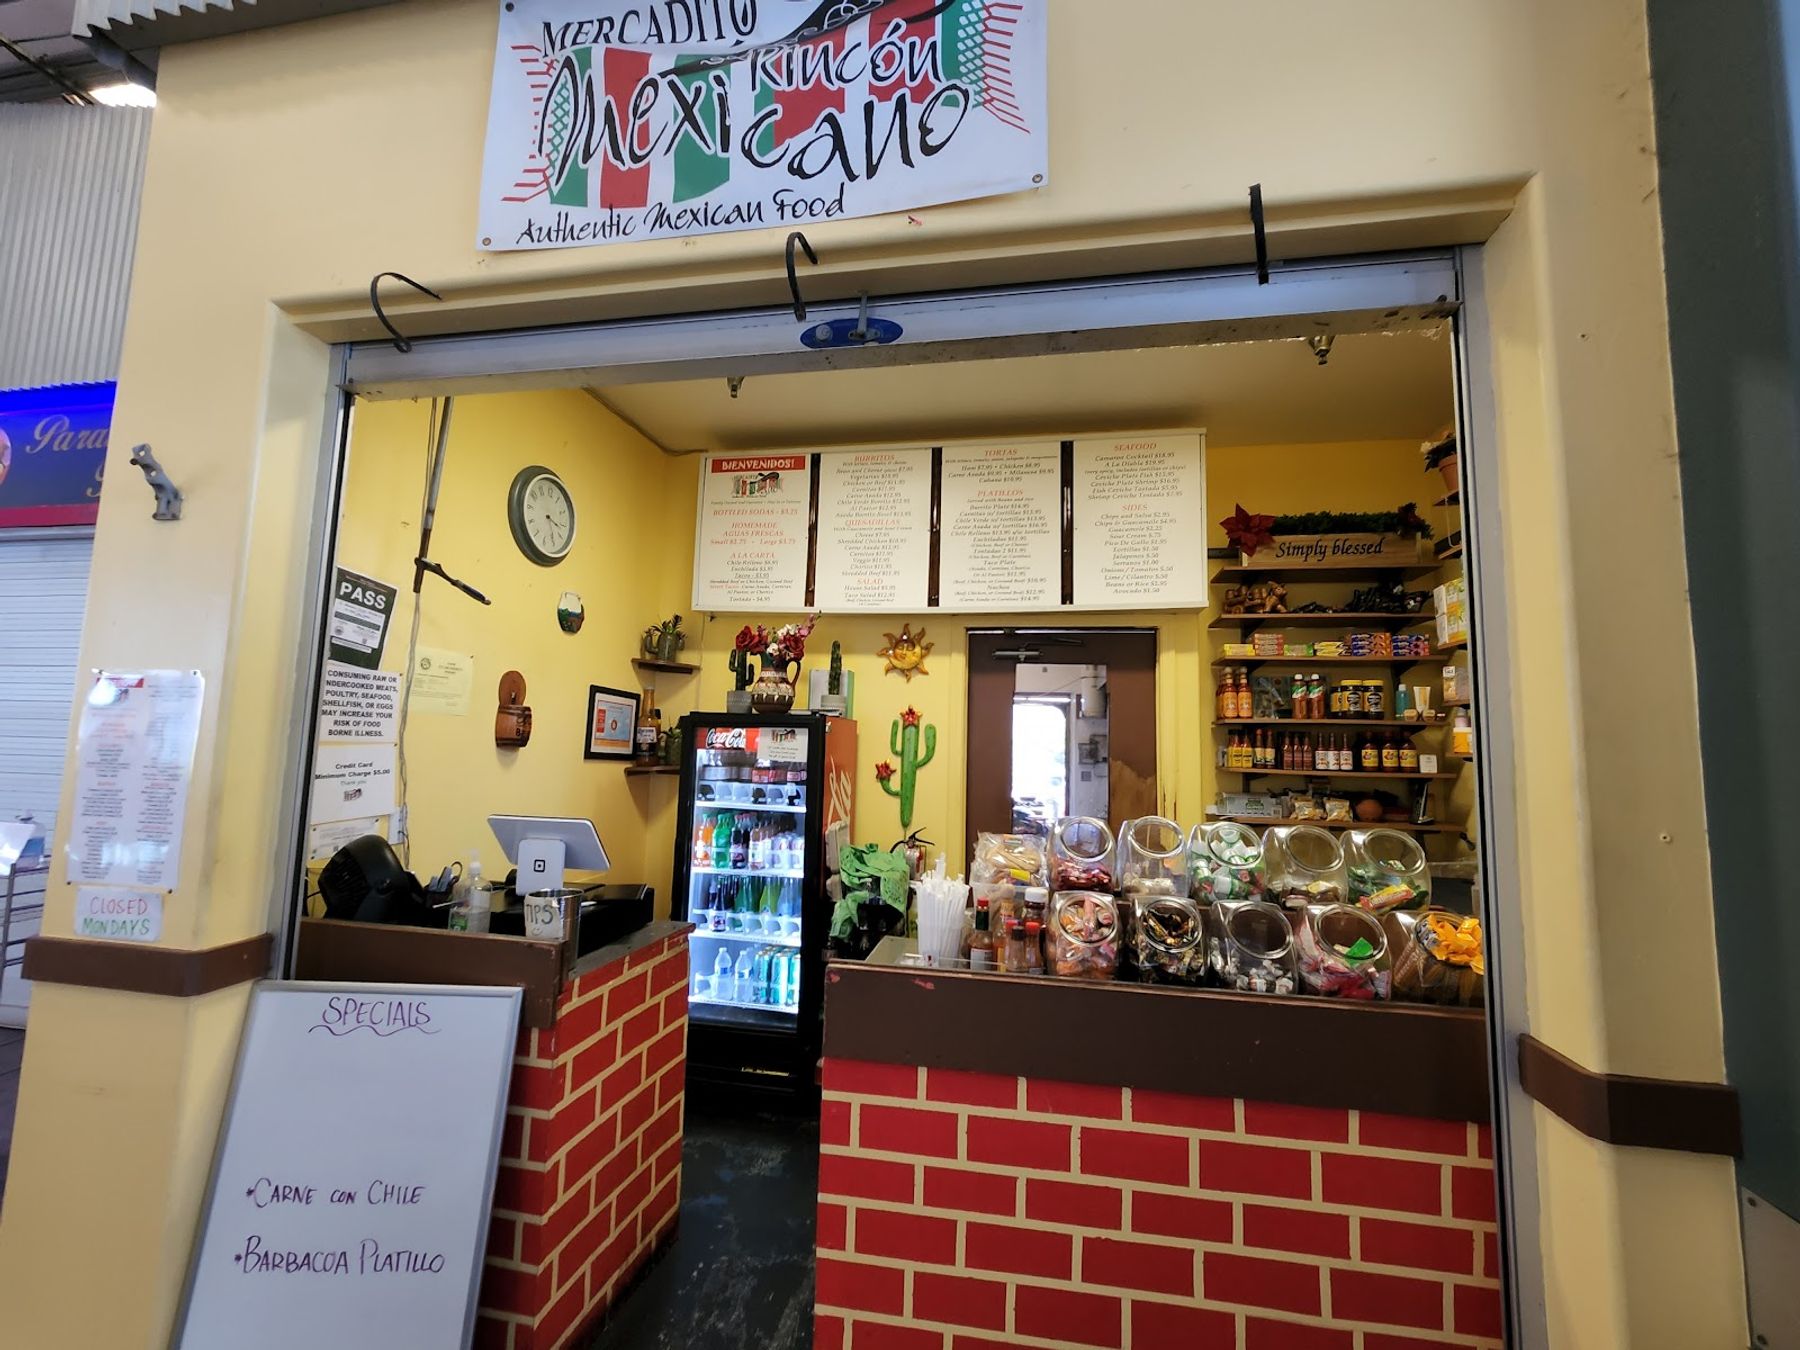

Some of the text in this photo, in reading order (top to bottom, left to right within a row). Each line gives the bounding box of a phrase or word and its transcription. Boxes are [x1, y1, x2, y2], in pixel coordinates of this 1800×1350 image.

[542, 0, 757, 58] MERCADITO
[751, 19, 943, 91] Rincón
[516, 182, 844, 244] Authentic Mexican Food
[1114, 443, 1157, 451] SEAFOOD
[722, 459, 795, 470] BIENVENIDOS!
[1276, 537, 1386, 562] Simply blessed
[340, 582, 386, 610] PASS
[327, 680, 374, 690] NDERCOOKED
[328, 670, 371, 680] CONSUMING
[322, 700, 363, 709] SHELLFISH,
[326, 690, 392, 701] POULTRY, SEAFOOD,
[90, 896, 148, 916] CLOSED
[526, 904, 553, 924] TIPS
[81, 917, 150, 937] MONDAYS
[321, 996, 431, 1027] SPECIALS
[252, 1177, 317, 1208] CARNE
[368, 1180, 426, 1205] CHILE
[243, 1235, 446, 1275] BARBACOA PLATILLO
